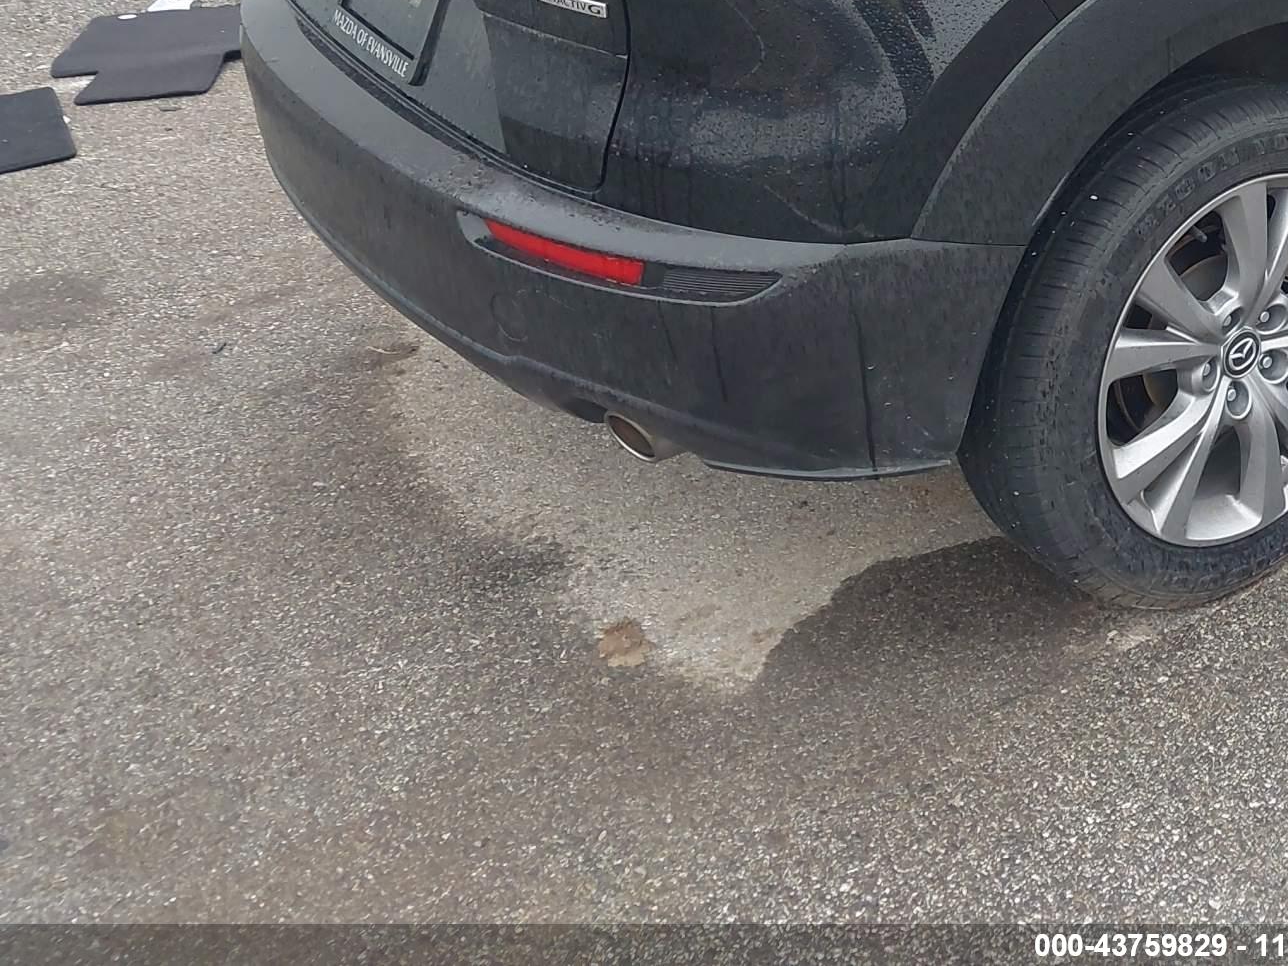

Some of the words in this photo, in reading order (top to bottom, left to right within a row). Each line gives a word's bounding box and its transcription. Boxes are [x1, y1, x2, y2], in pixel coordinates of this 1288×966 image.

[333, 9, 358, 40] MAZDA
[356, 28, 369, 48] OF
[366, 36, 409, 78] EVANSVILLE
